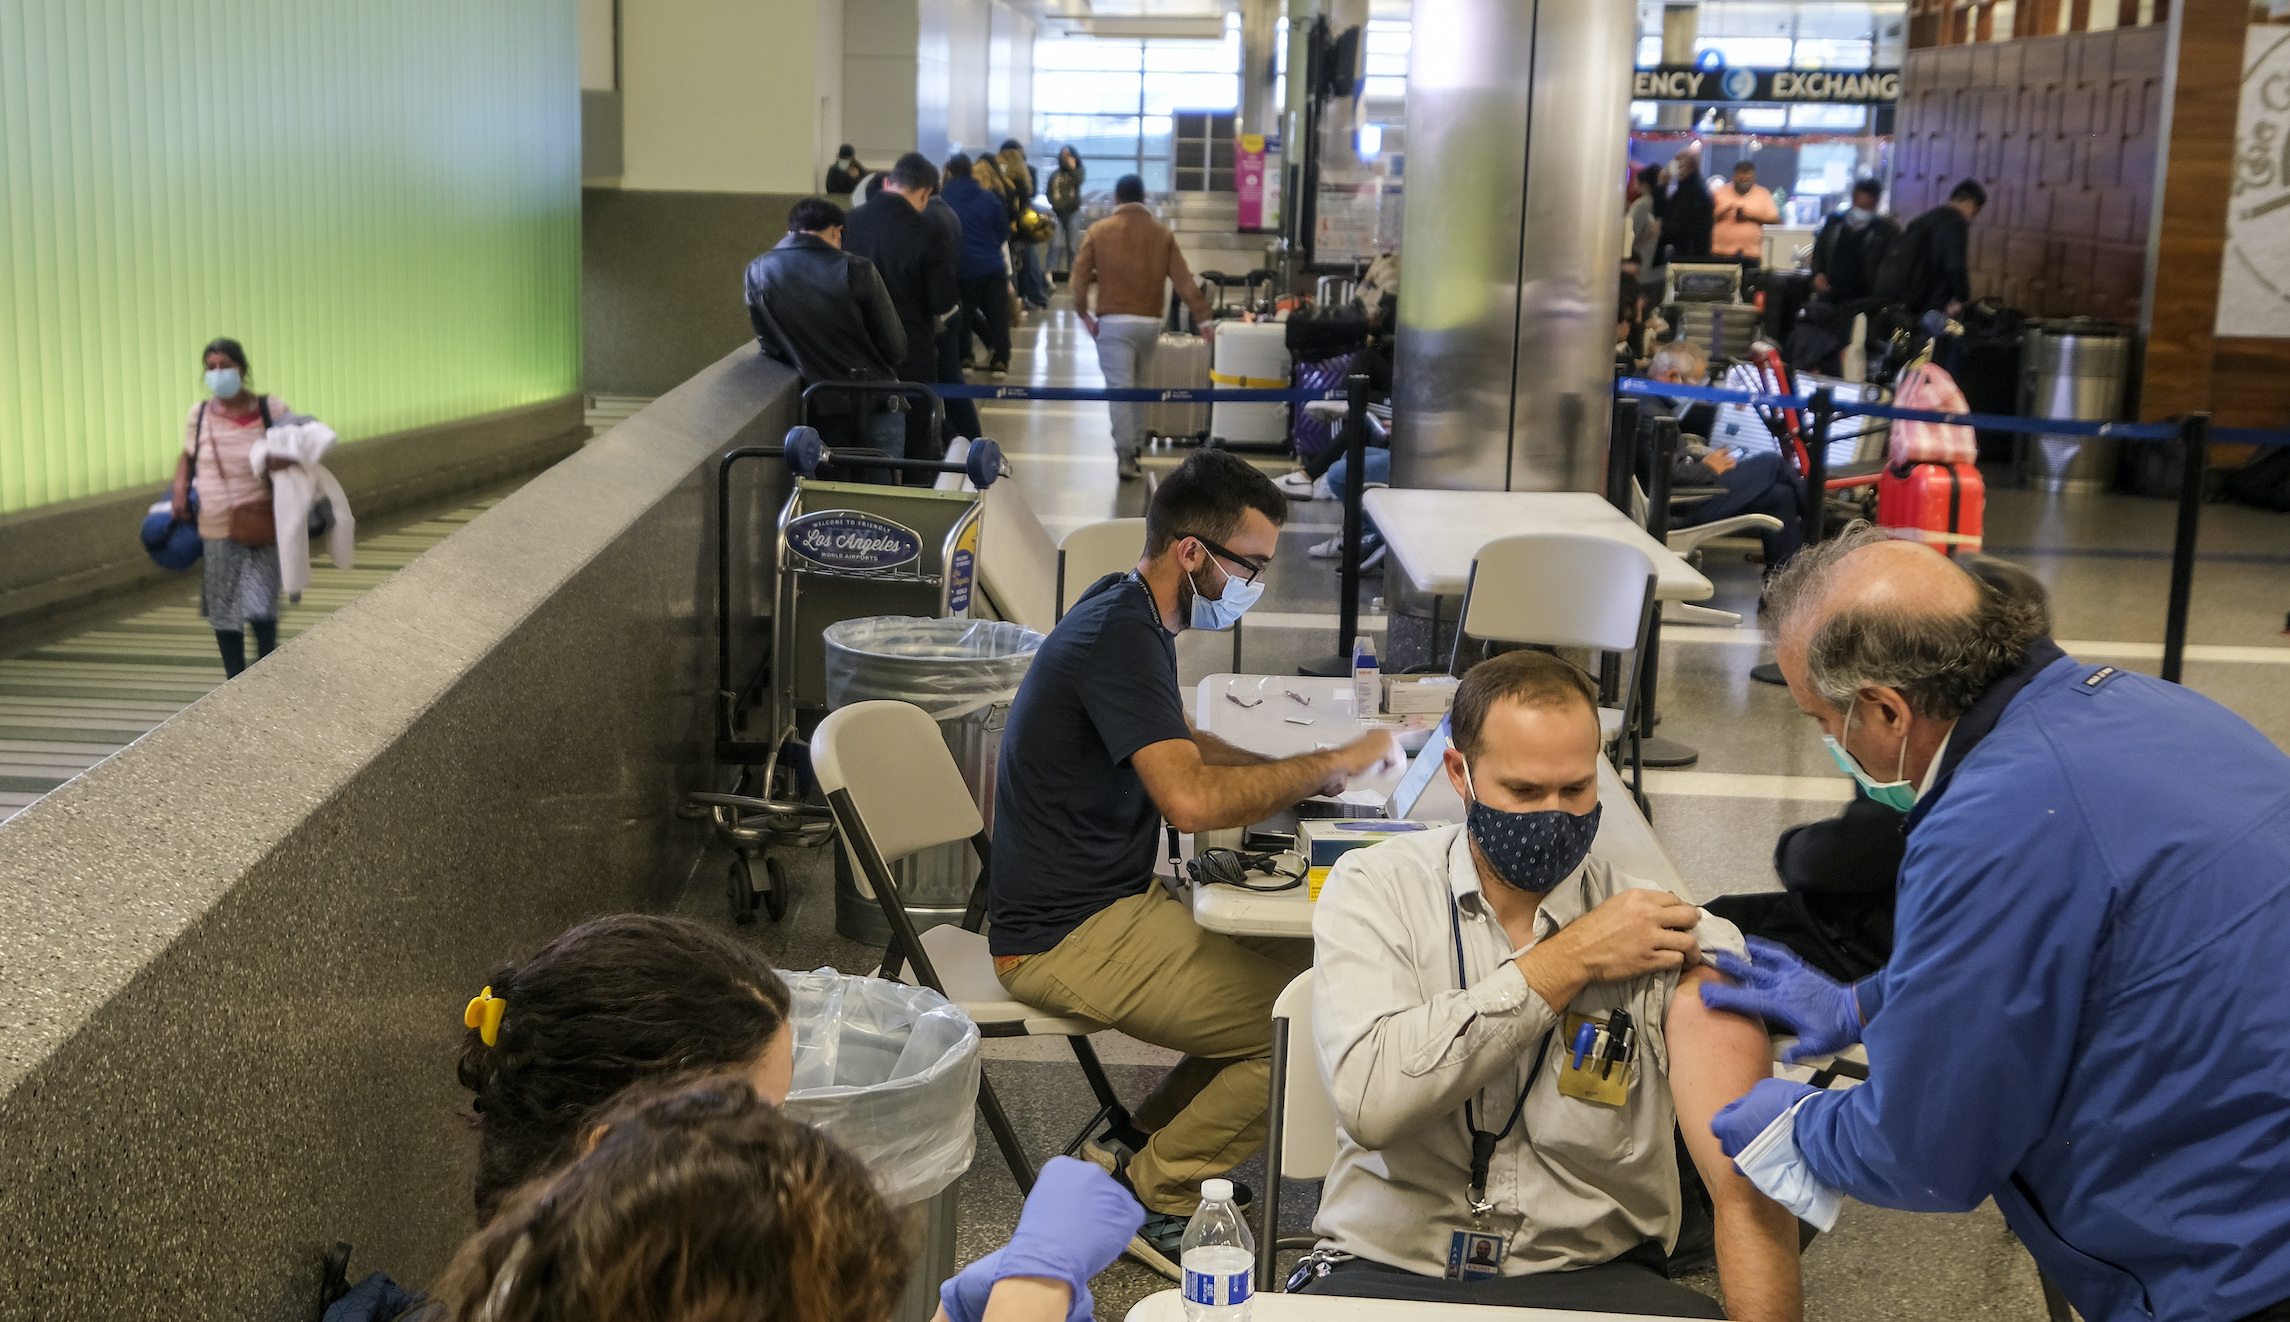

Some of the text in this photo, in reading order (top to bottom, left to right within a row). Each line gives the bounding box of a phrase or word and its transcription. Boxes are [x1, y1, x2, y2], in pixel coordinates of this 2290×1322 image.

[1633, 71, 1705, 98] ENCY
[813, 519, 844, 528] WELCOME
[857, 520, 892, 533] FRIENDLY
[802, 529, 901, 555] Los Angeles
[844, 553, 878, 561] AIRPORTS
